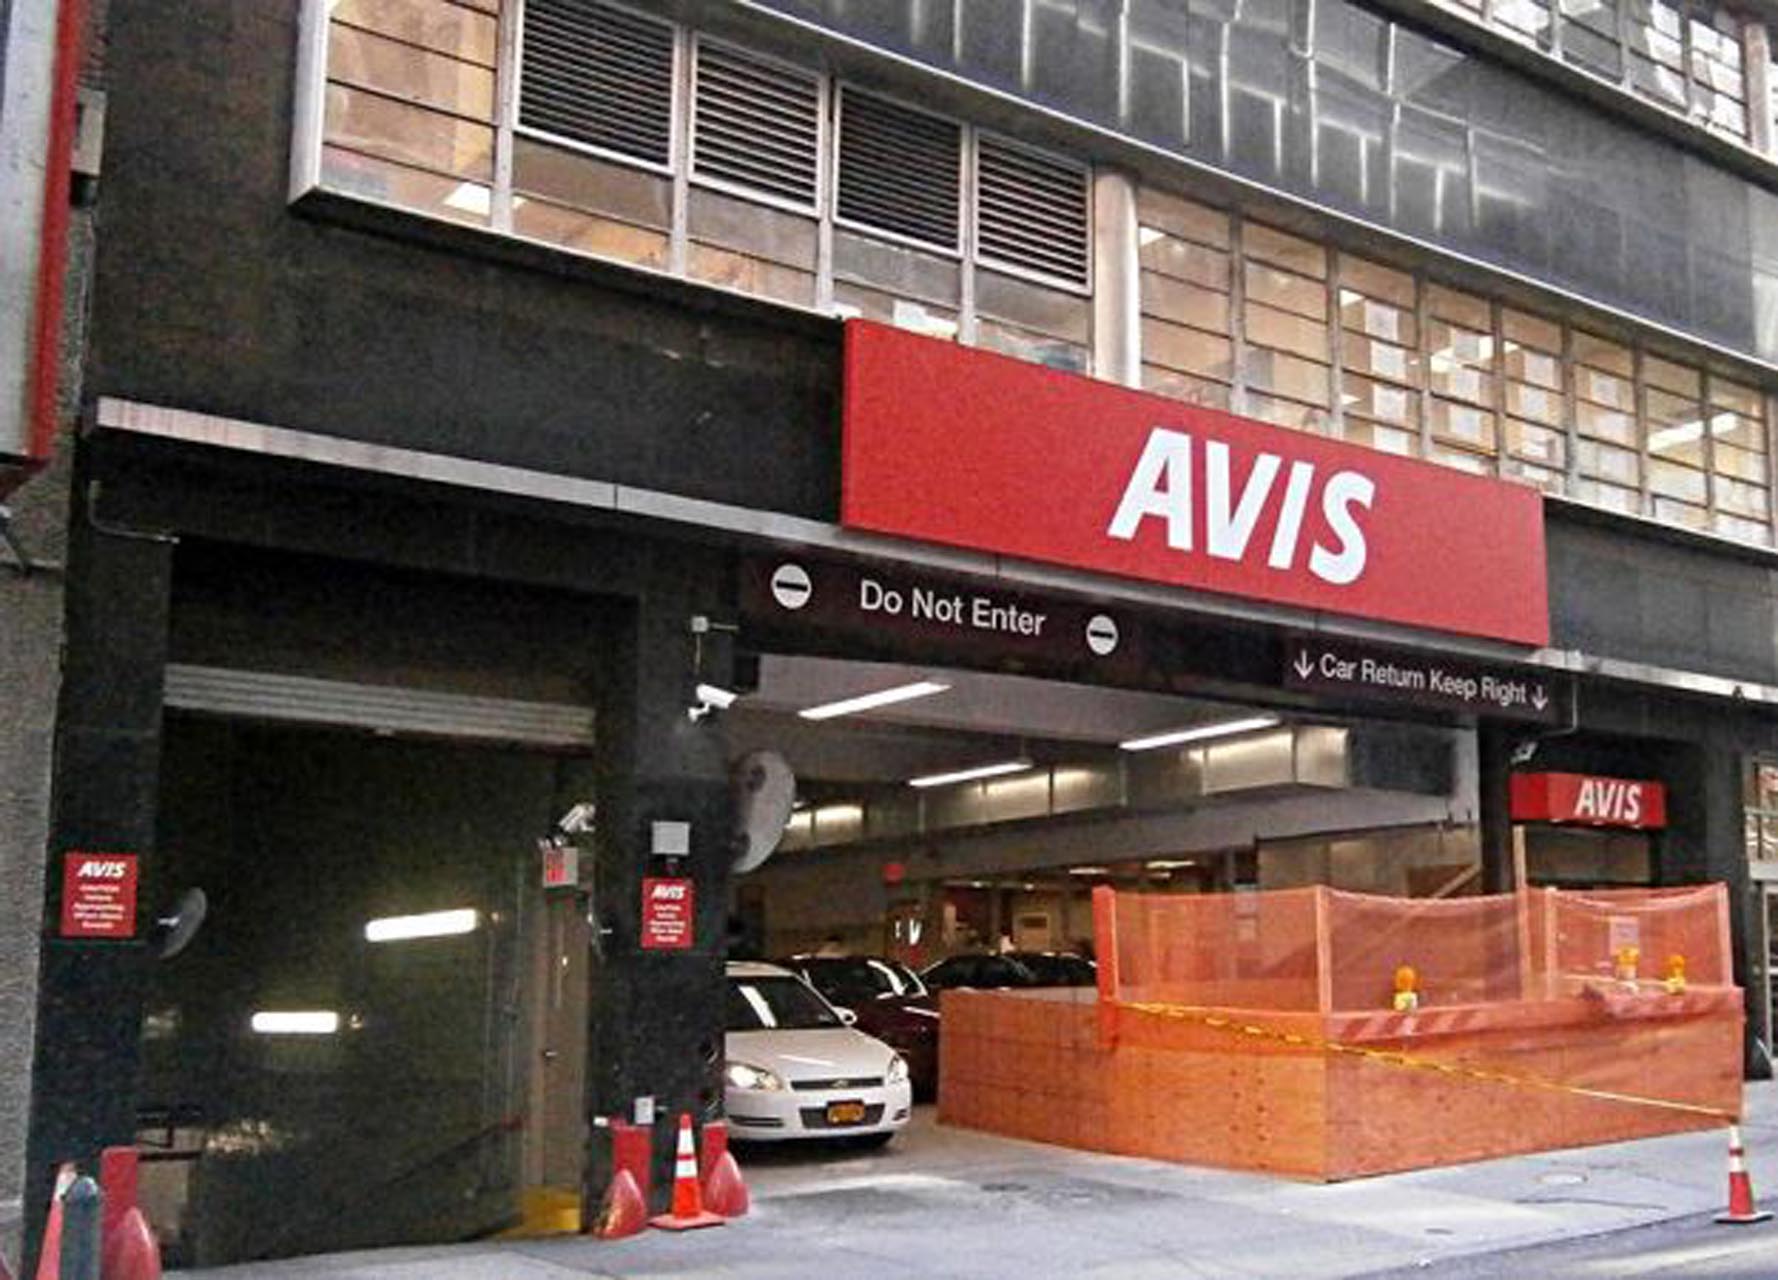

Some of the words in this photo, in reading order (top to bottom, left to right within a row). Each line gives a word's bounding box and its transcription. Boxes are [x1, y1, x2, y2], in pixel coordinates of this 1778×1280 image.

[1107, 427, 1375, 585] AVIS
[860, 579, 902, 614] Do
[912, 588, 962, 624] Not
[972, 599, 1046, 636] Enter
[1319, 653, 1357, 680] Car
[1361, 659, 1425, 690] Return
[1430, 669, 1477, 700] Keep
[1481, 676, 1528, 706] Right
[1574, 779, 1641, 821] AVIS
[77, 861, 126, 878] AVIS
